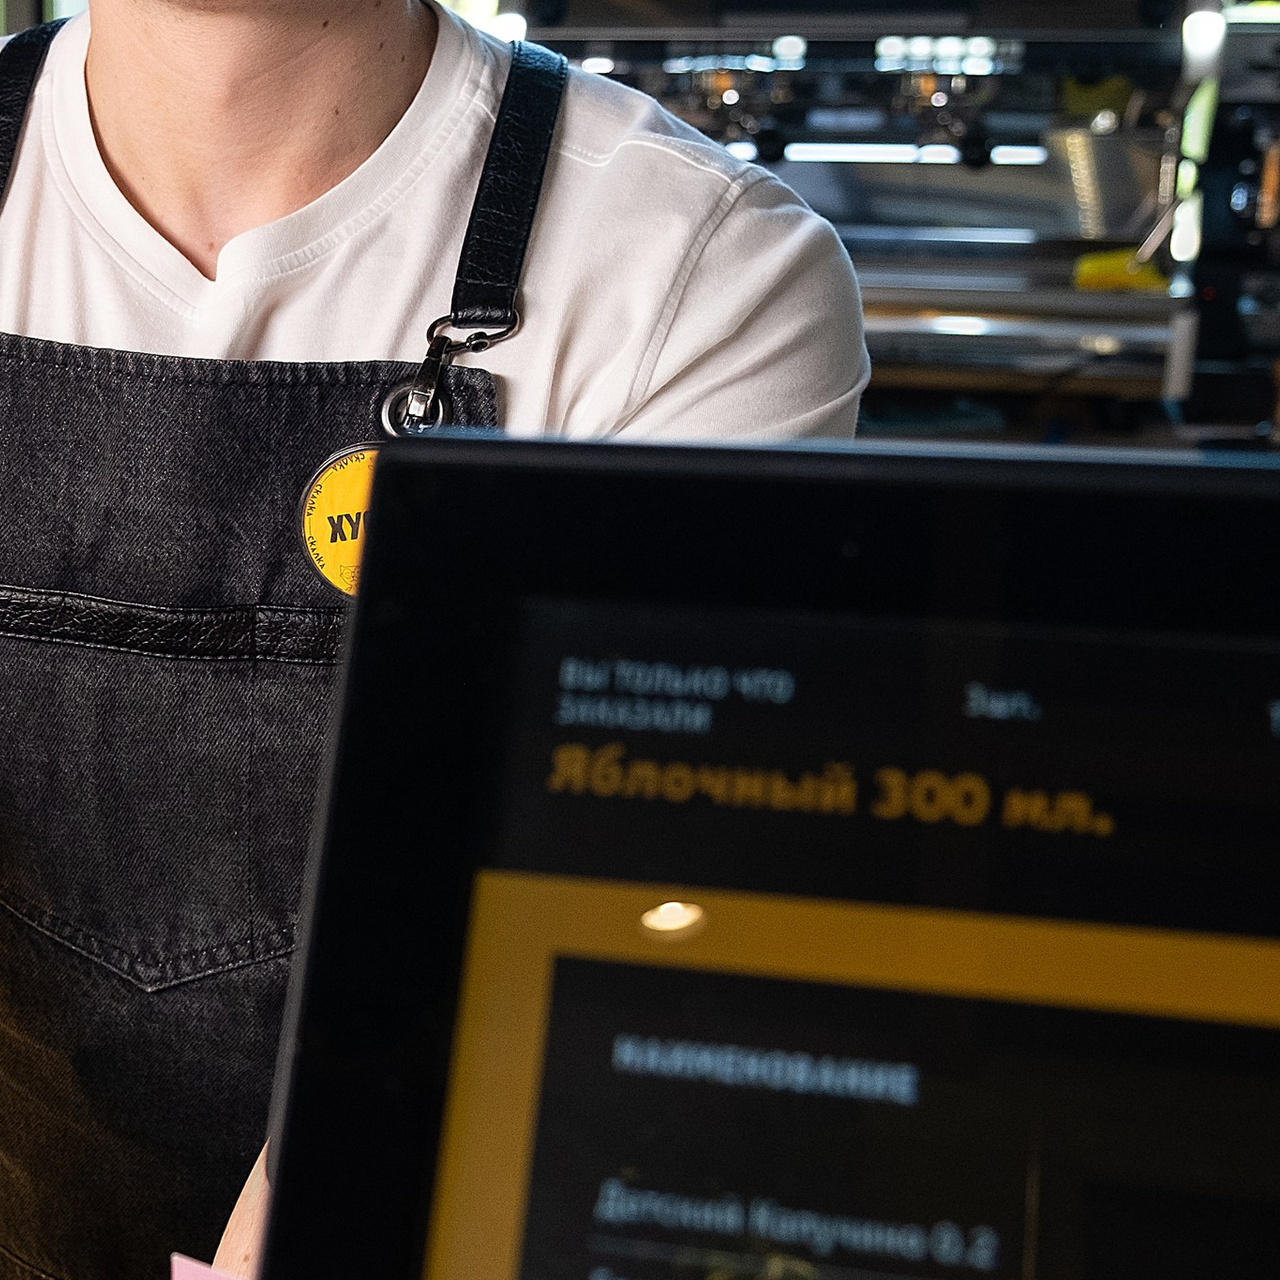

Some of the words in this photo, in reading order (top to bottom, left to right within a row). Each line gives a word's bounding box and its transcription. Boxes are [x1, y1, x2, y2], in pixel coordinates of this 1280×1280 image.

[306, 483, 323, 517] СКАЛКА
[327, 510, 370, 544] ХУ
[307, 535, 326, 570] СКАЛКА
[548, 742, 856, 815] Яблочный
[872, 768, 990, 825] 300
